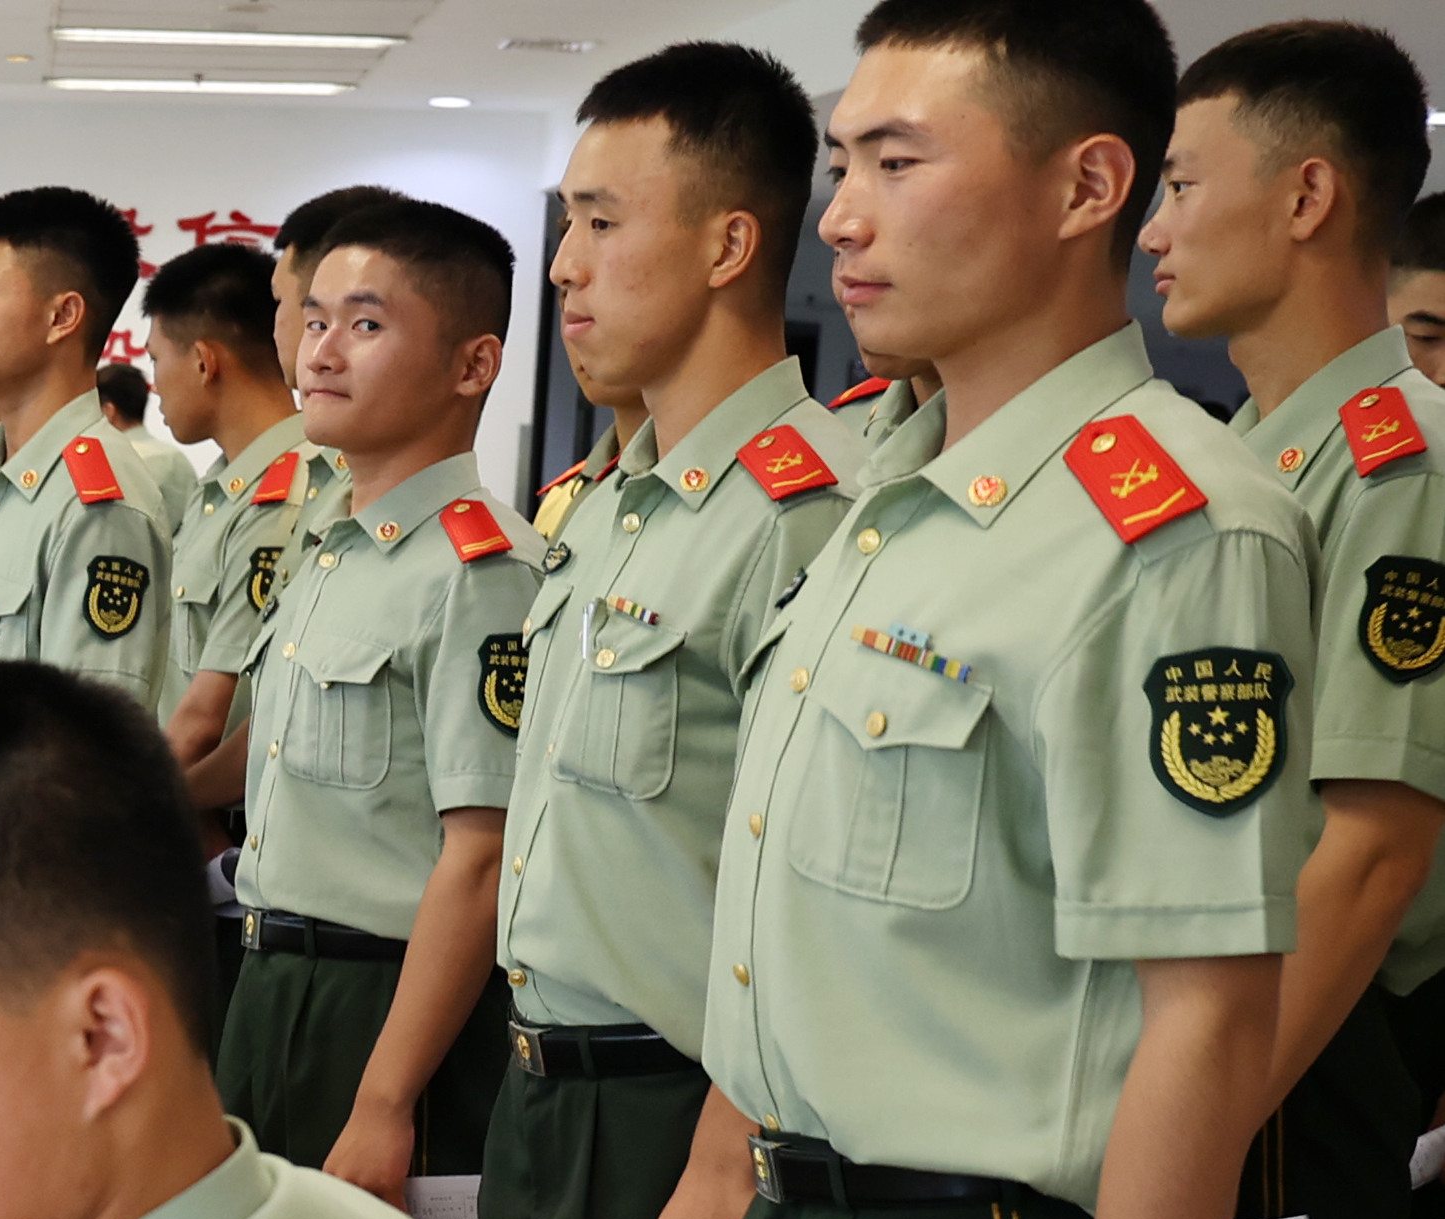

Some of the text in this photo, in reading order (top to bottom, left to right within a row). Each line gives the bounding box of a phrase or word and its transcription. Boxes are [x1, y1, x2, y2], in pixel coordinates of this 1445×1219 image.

[1165, 658, 1273, 683] 中国人民
[1165, 682, 1272, 703] 武装警察部队
